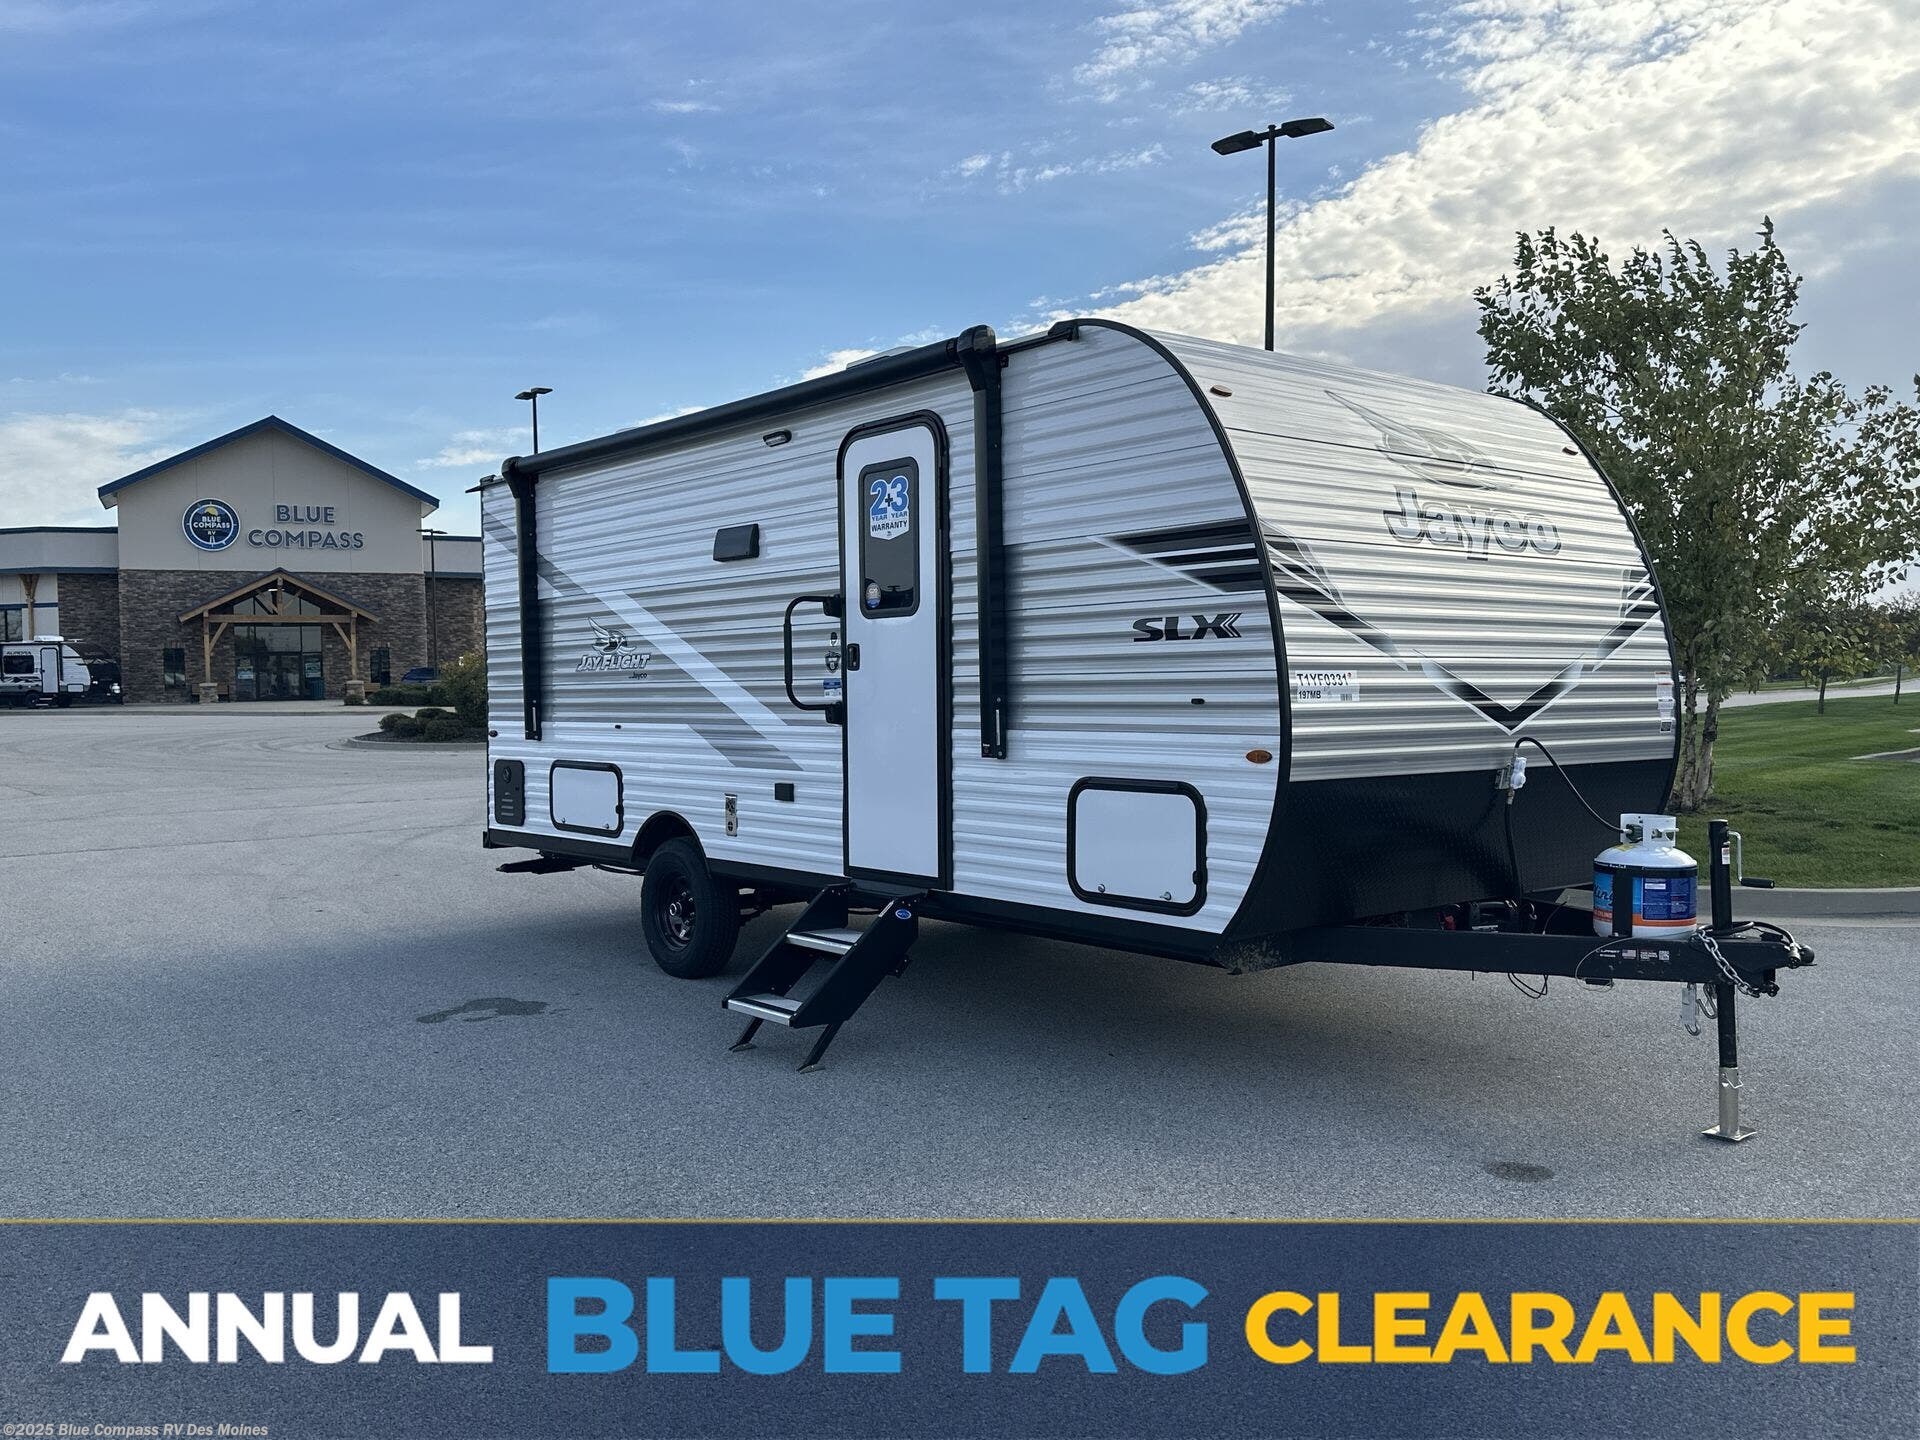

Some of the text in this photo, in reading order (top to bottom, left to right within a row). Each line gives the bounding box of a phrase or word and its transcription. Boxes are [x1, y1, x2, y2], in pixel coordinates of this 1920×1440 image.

[276, 504, 335, 524] BLUE
[1383, 485, 1561, 561] Jayco
[871, 520, 907, 531] WARRANTY
[248, 529, 364, 549] COMPASS
[575, 653, 651, 672] JAY FLIGHT
[1299, 690, 1321, 699] 197MB
